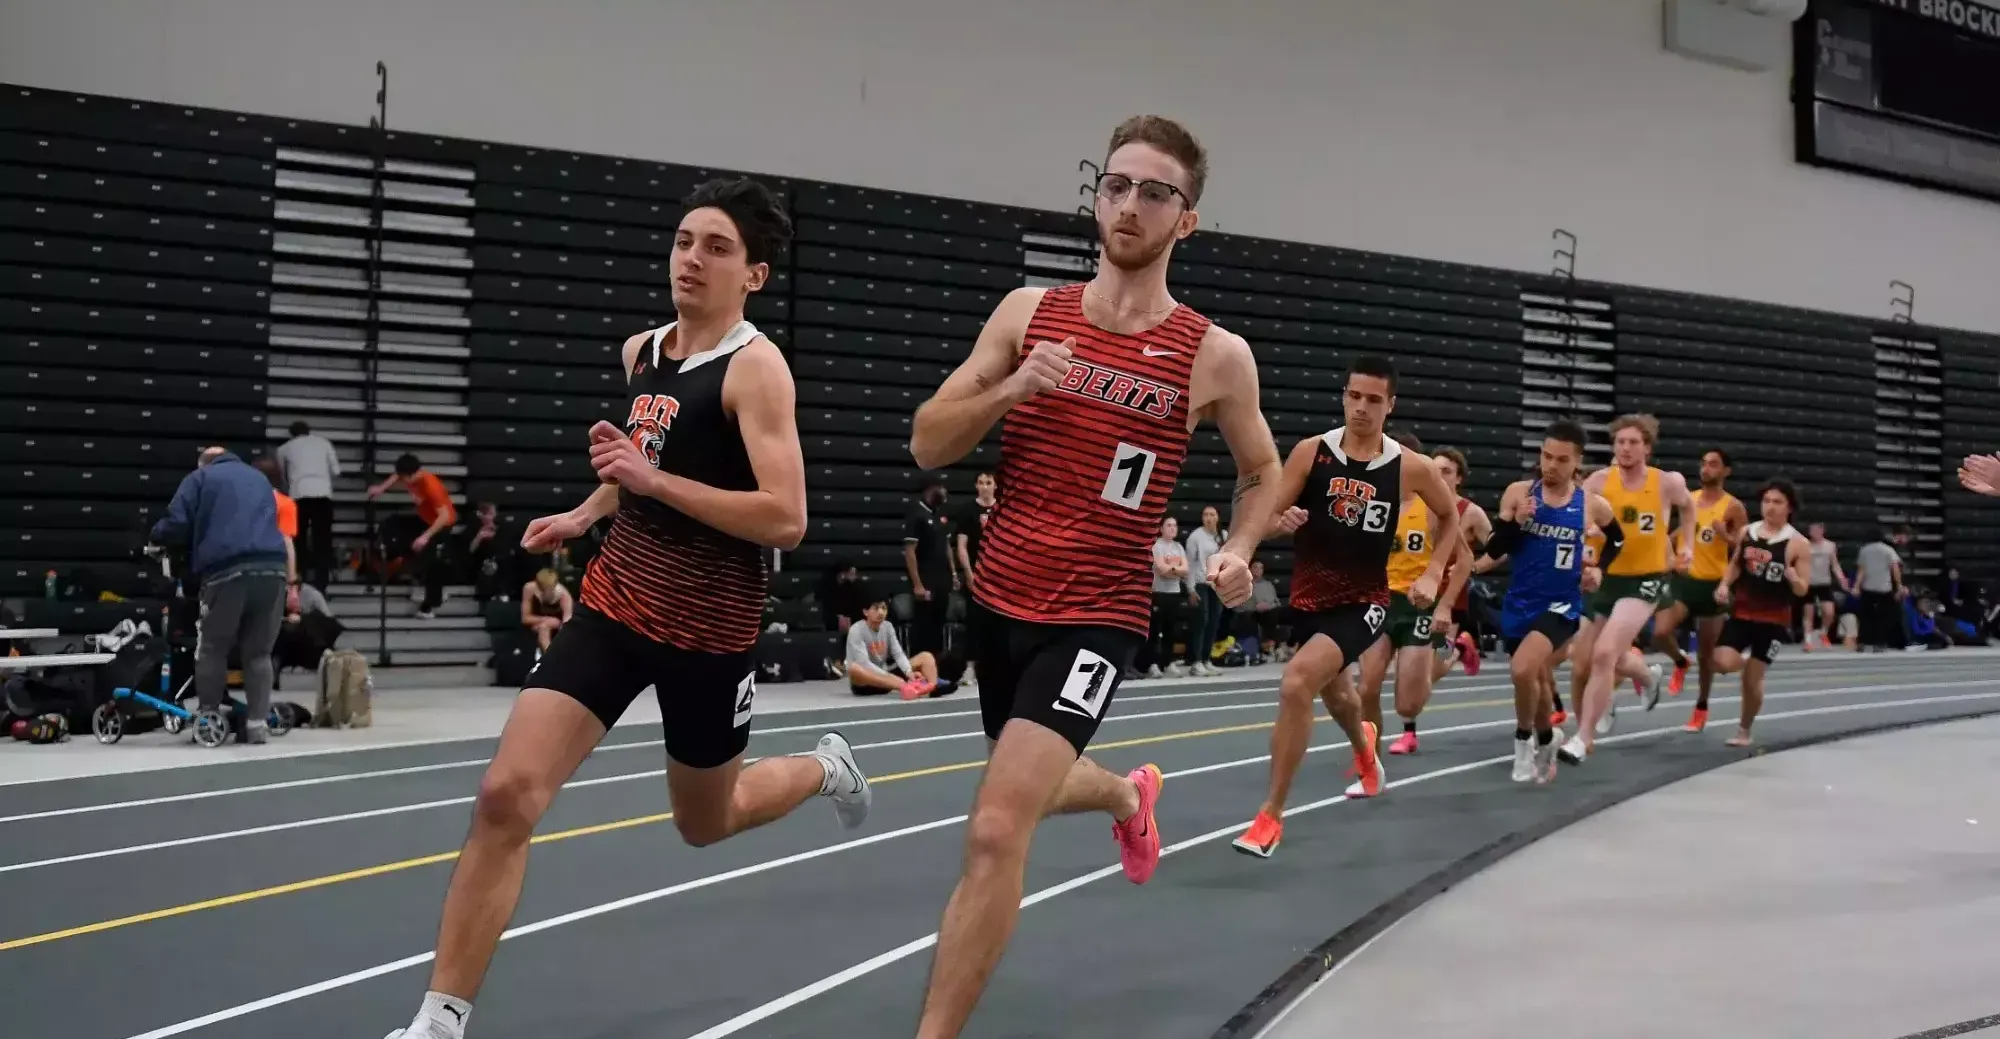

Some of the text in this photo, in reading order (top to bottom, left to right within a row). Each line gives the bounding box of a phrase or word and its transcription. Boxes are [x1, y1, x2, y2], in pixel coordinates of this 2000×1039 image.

[1058, 361, 1176, 418] BERTS
[626, 394, 680, 431] RIT
[1117, 452, 1148, 500] 1
[1326, 477, 1377, 502] RIT
[1366, 504, 1388, 530] 3
[1640, 514, 1654, 531] 2
[1408, 533, 1424, 551] 8
[1701, 529, 1713, 542] 6
[1558, 546, 1573, 566] 7
[1368, 606, 1384, 630] 3
[1416, 616, 1432, 635] 8
[735, 676, 754, 714] 4
[1078, 660, 1109, 706] 1
